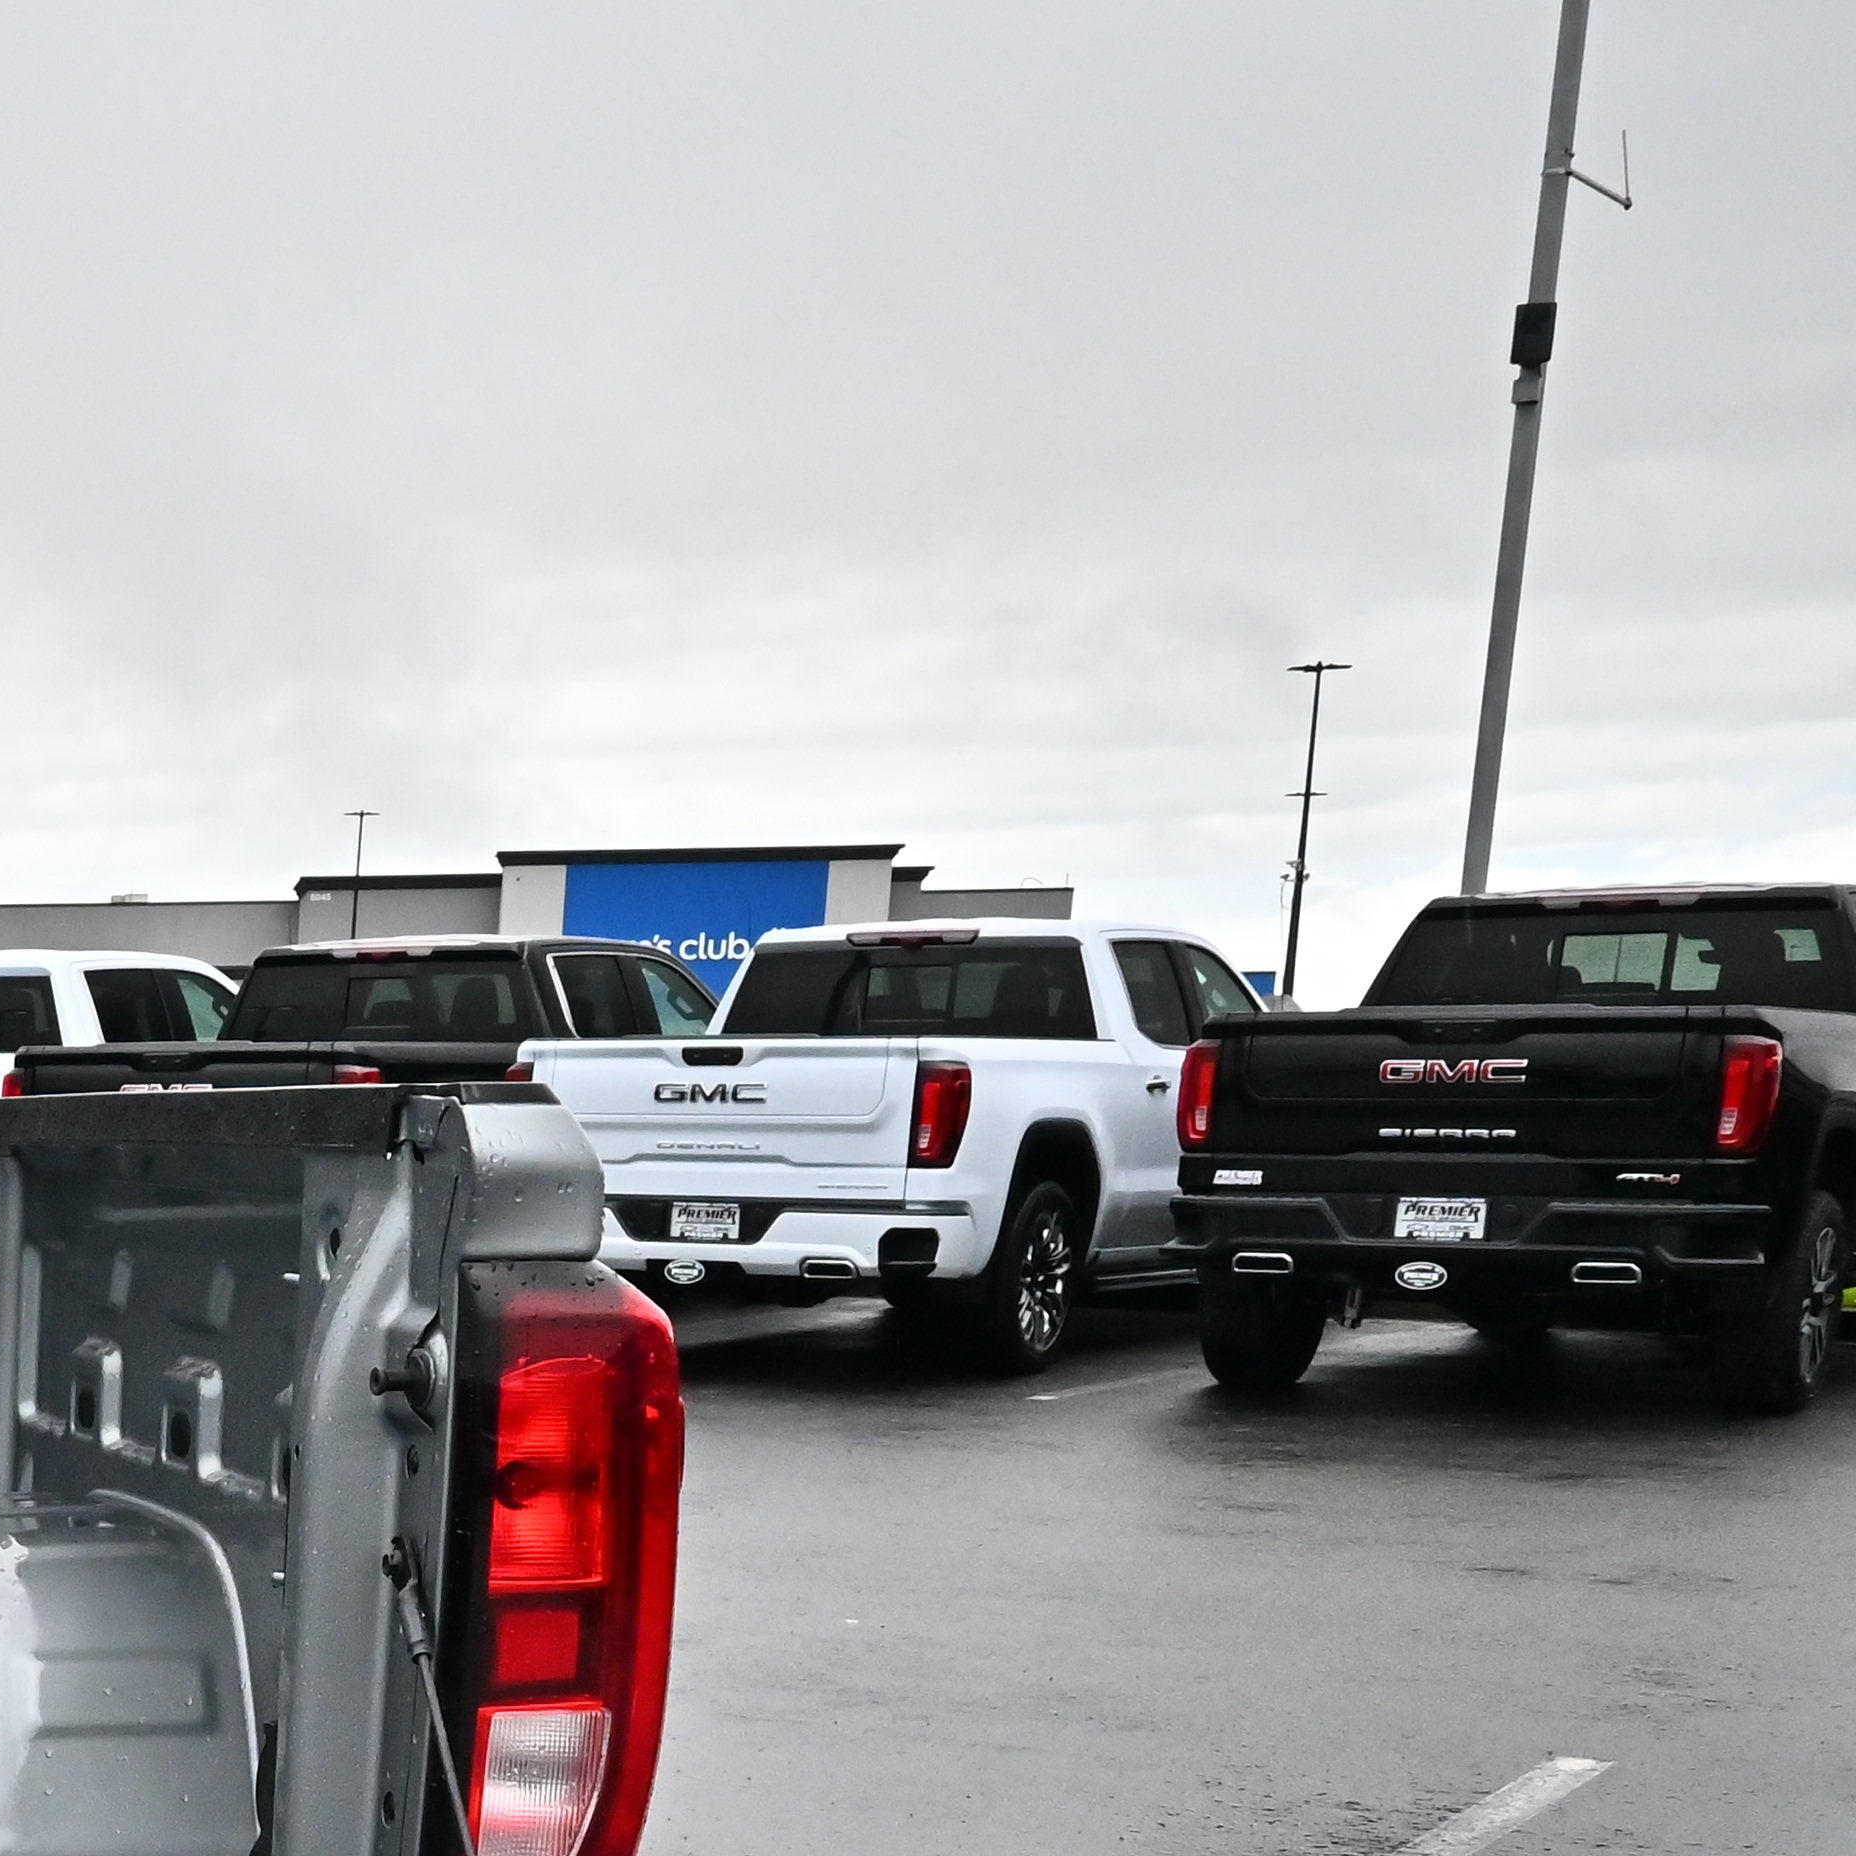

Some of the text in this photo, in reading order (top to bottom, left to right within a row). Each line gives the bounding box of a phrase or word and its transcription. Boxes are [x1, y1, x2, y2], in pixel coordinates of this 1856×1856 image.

[679, 931, 750, 961] club
[1379, 1059, 1529, 1084] GMC
[654, 1082, 768, 1104] GMC
[1378, 1128, 1517, 1139] SIERRA
[656, 1141, 761, 1151] DENALI
[677, 1206, 738, 1224] PREMIER
[1404, 1203, 1481, 1222] PREMIER
